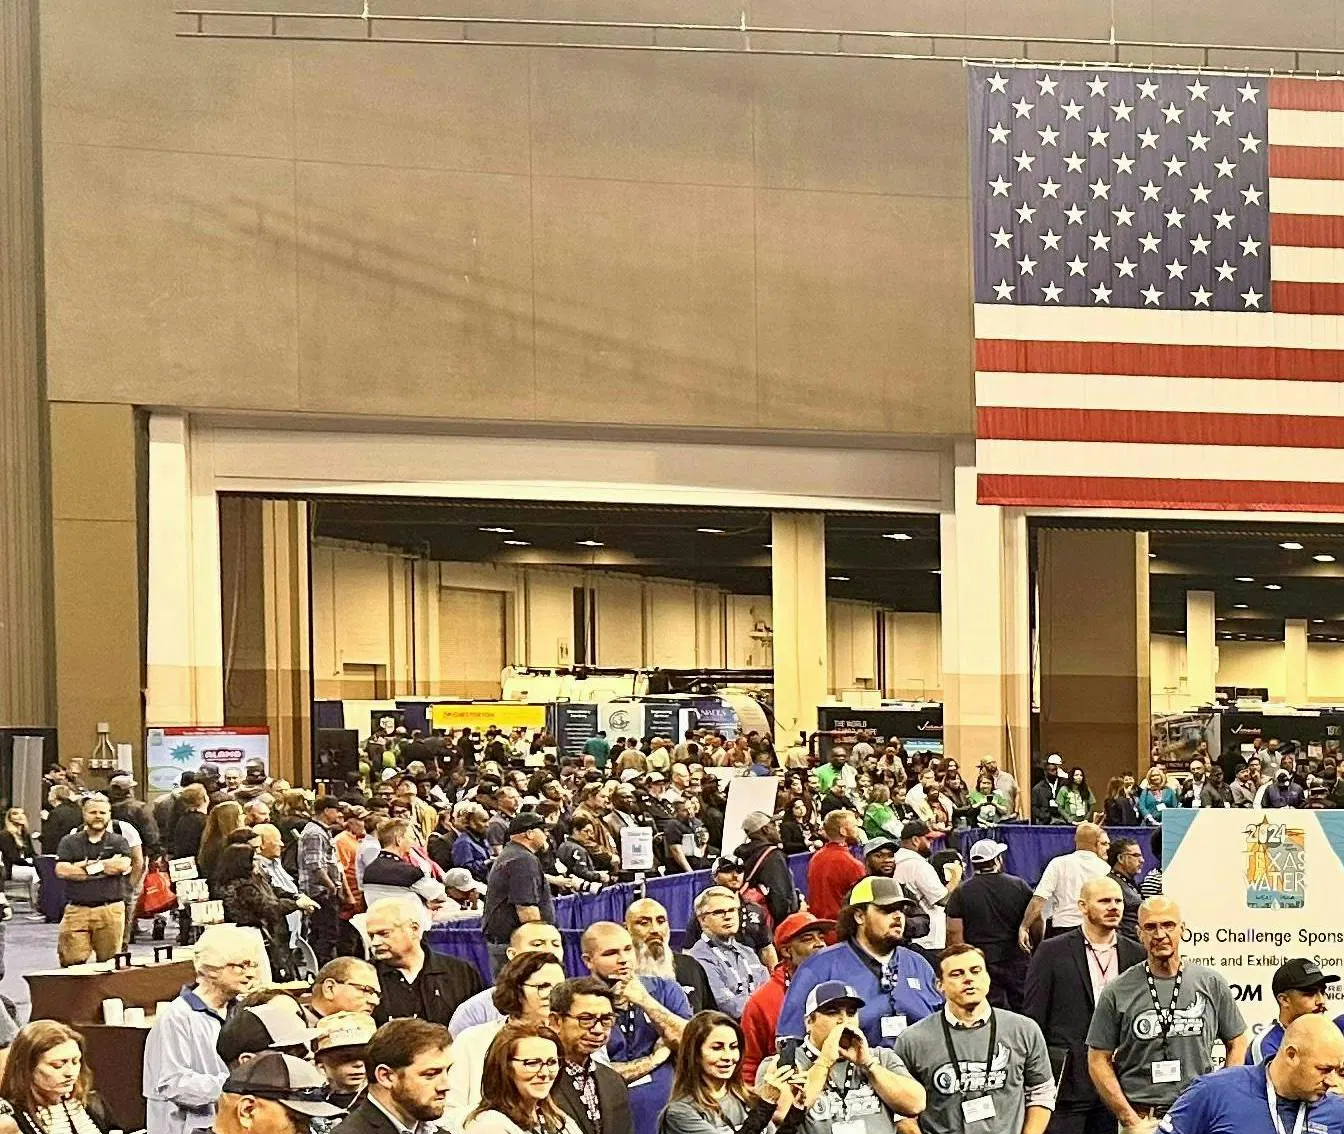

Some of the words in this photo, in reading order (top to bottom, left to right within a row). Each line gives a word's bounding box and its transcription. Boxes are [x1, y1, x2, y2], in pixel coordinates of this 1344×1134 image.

[1245, 823, 1287, 844] 2024
[1243, 850, 1305, 872] TEXAS
[1245, 872, 1305, 892] WATER
[1180, 928, 1210, 946] Ops
[1216, 928, 1292, 947] Challenge
[1220, 954, 1243, 967] and
